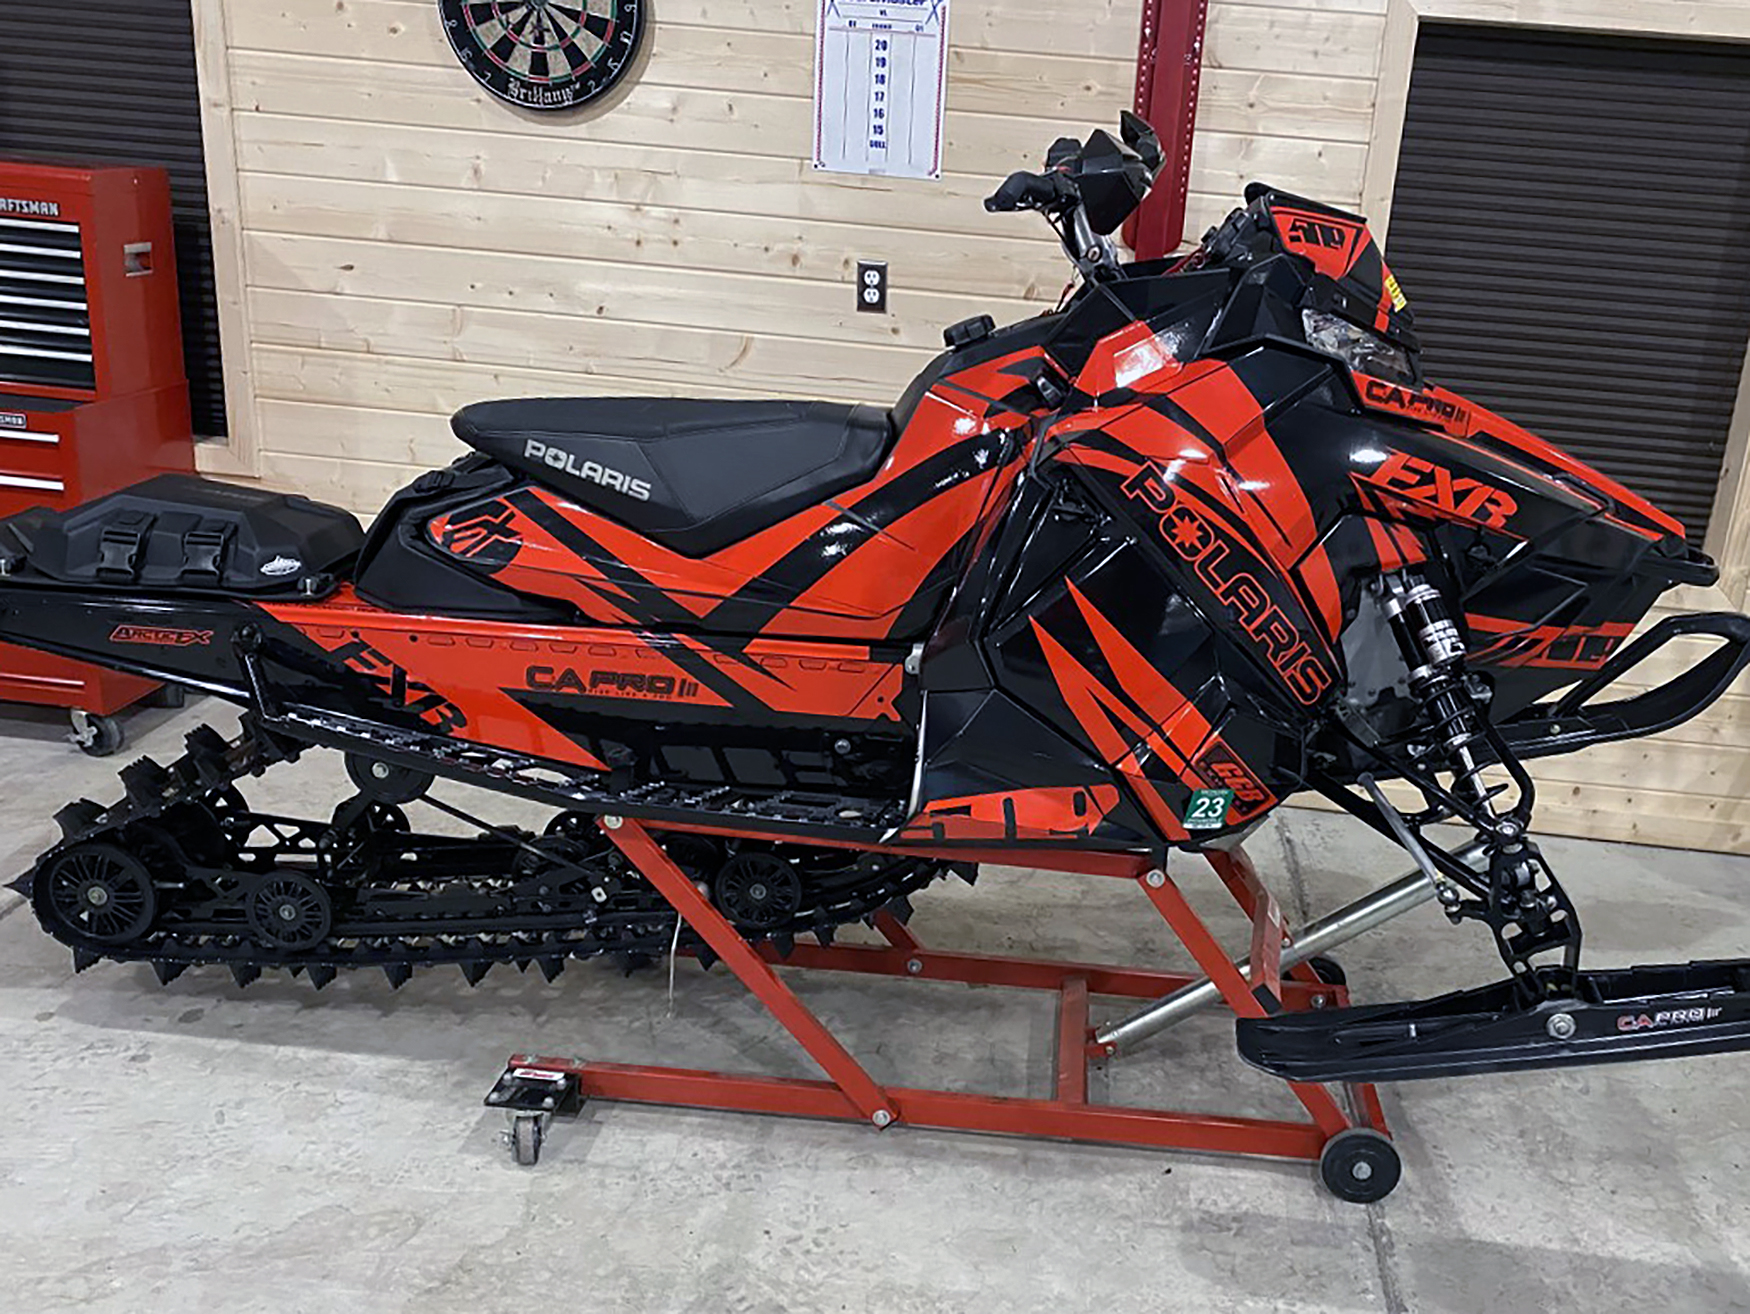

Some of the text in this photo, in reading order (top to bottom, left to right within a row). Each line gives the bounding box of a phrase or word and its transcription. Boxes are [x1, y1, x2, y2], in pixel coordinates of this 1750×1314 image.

[875, 39, 888, 51] 20
[874, 91, 885, 102] 17
[873, 108, 885, 119] 16
[872, 124, 884, 135] 15
[524, 439, 652, 501] POLARIS
[1120, 461, 1332, 705] POLARIS
[1190, 796, 1225, 818] 23
